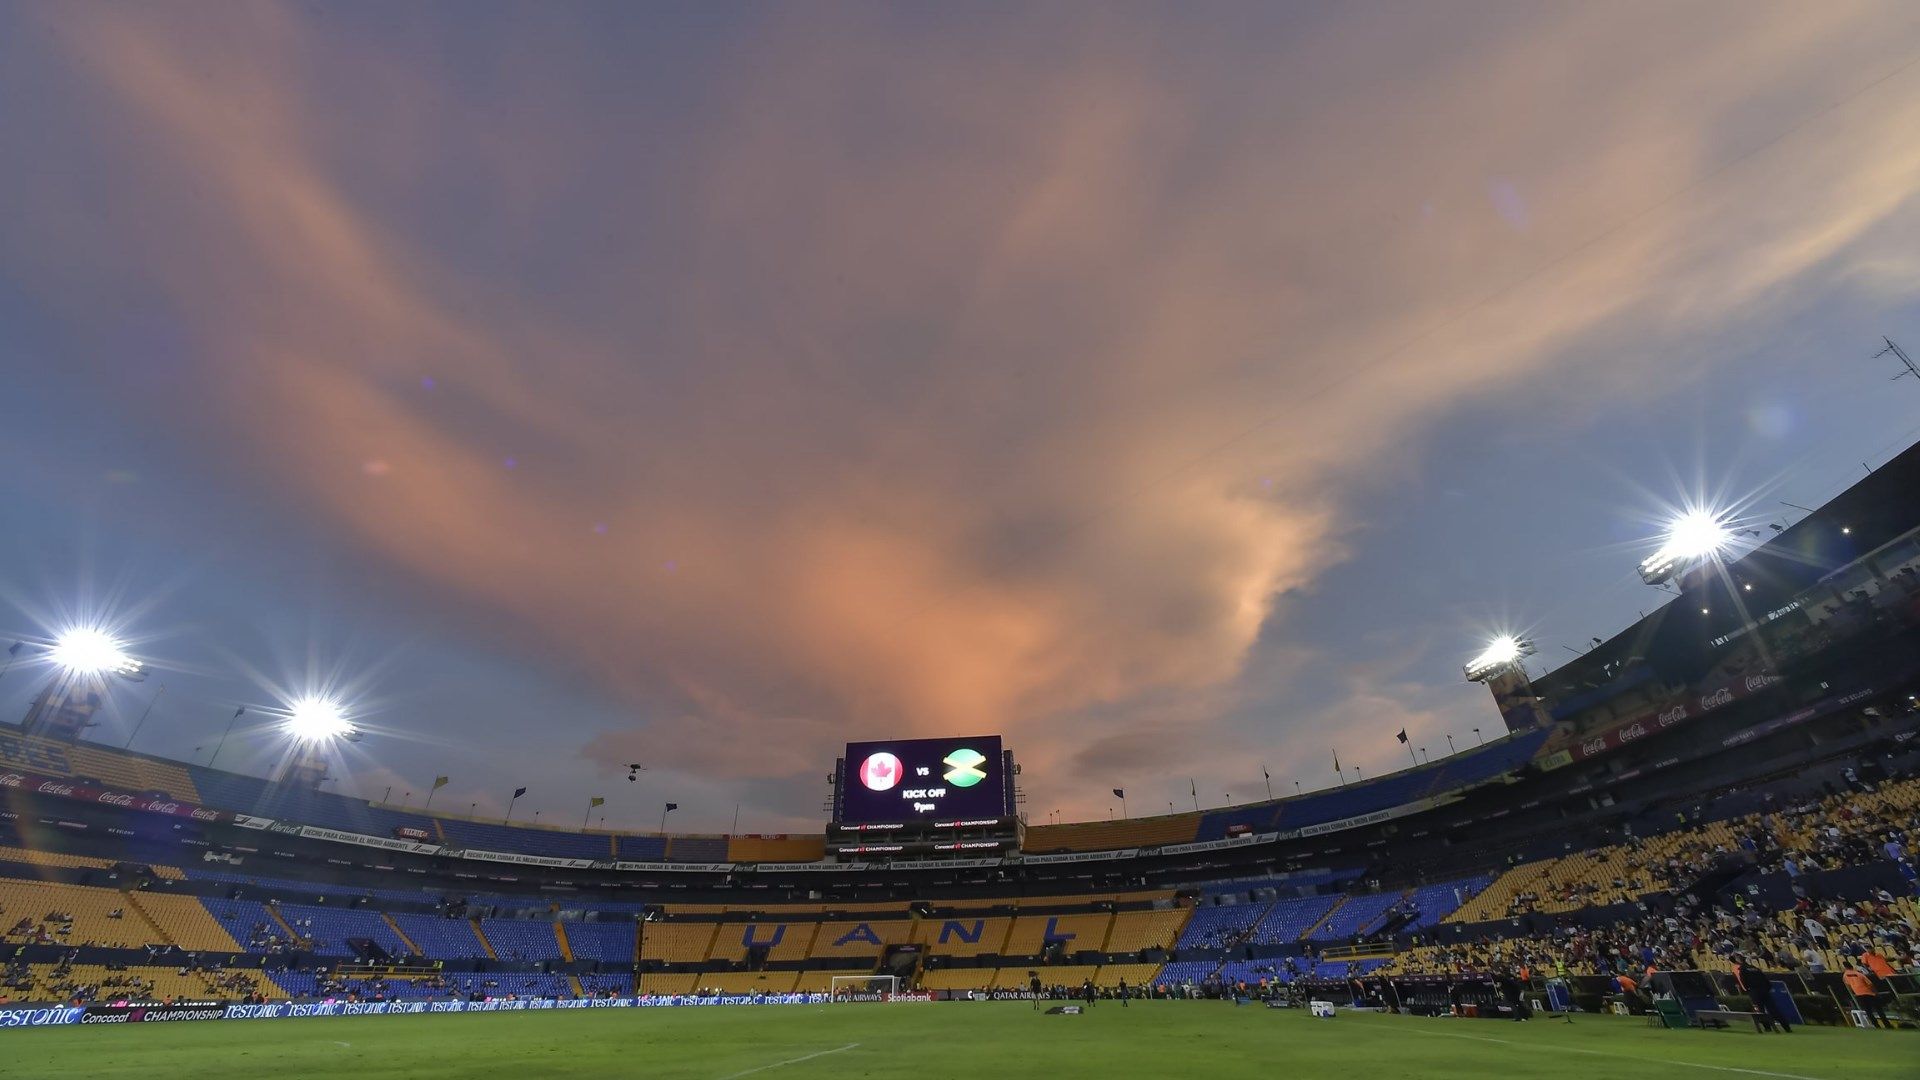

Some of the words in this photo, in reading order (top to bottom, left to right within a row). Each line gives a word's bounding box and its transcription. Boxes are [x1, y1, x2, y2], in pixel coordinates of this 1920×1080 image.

[1701, 688, 1732, 710] Coca-Cola
[1659, 705, 1687, 727] Coca-Cola
[1619, 723, 1646, 742] Coca-Cola
[1583, 738, 1607, 756] Coca-Cola
[39, 781, 74, 796] Coca-Cola
[902, 789, 927, 799] KICK
[928, 788, 947, 798] OFF
[99, 791, 135, 806] Coca-Cola
[148, 800, 179, 814] Coca-Cola
[191, 807, 219, 821] Coca-Cola
[913, 801, 935, 813] 9pm
[271, 822, 297, 833] Vertua
[960, 819, 998, 827] CHAMPIONSHIP
[338, 834, 358, 842] CUIDAR
[853, 993, 882, 1002] AIRWAYS
[888, 993, 931, 1002] Scotiabank
[993, 991, 1017, 1000] QATAR
[81, 1012, 130, 1024] Concacaf
[143, 1009, 223, 1022] CHAMPIONSHIP
